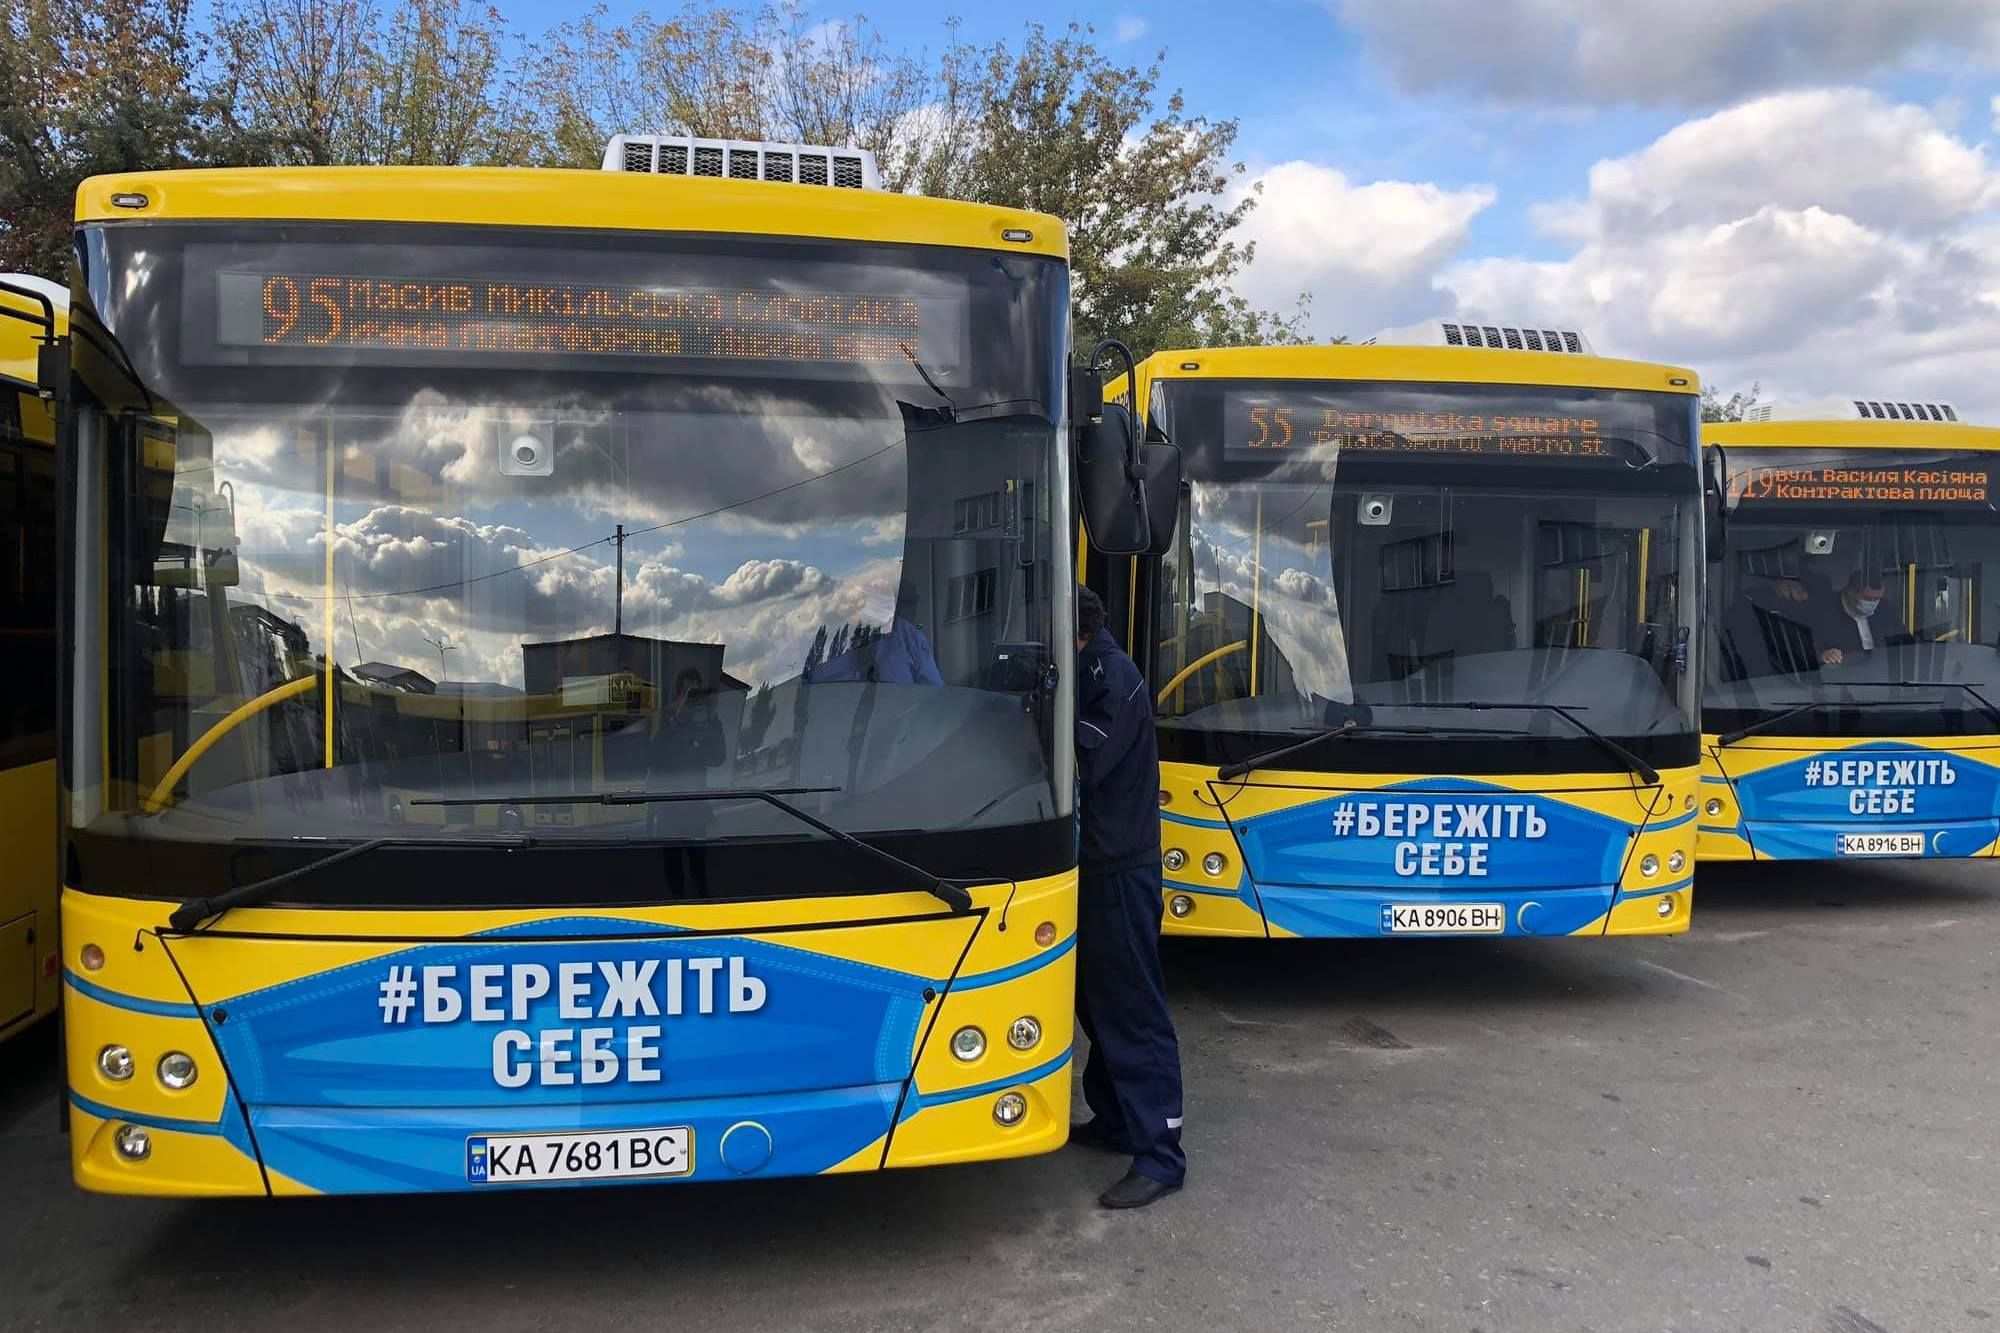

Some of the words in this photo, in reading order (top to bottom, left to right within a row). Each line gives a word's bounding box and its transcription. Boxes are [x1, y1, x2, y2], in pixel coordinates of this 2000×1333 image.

[263, 276, 342, 344] 95
[349, 278, 472, 312] Масив
[487, 283, 722, 320] Микільська
[1247, 407, 1293, 448] 55
[1493, 414, 1598, 434] square
[1498, 435, 1573, 454] Metro
[1727, 464, 1774, 498] 119
[1775, 469, 1817, 482] вул.
[1823, 468, 1899, 484] Василя
[1903, 470, 1988, 485] Касіяна
[1776, 484, 1914, 500] Контрактова
[1919, 486, 1985, 501] площа
[1805, 760, 1956, 786] #БЕРЕЖІТЬ
[1849, 788, 1915, 814] СЕБЕ
[1333, 802, 1547, 838] #БЕРЕЖІТЬ
[1395, 841, 1489, 876] СЕБЕ
[1846, 838, 1865, 851] KA
[1868, 838, 1897, 851] 8916
[1901, 838, 1920, 851] BH
[1394, 909, 1420, 927] KA
[1425, 909, 1467, 927] 8906
[1471, 908, 1498, 926] BH
[378, 956, 767, 1023] #БЕРЕЖІТЬ
[492, 1026, 661, 1088] СЕБЕ
[471, 1166, 486, 1176] UA
[490, 1144, 537, 1176] KA
[545, 1140, 620, 1173] 7681
[630, 1136, 676, 1168] BC
